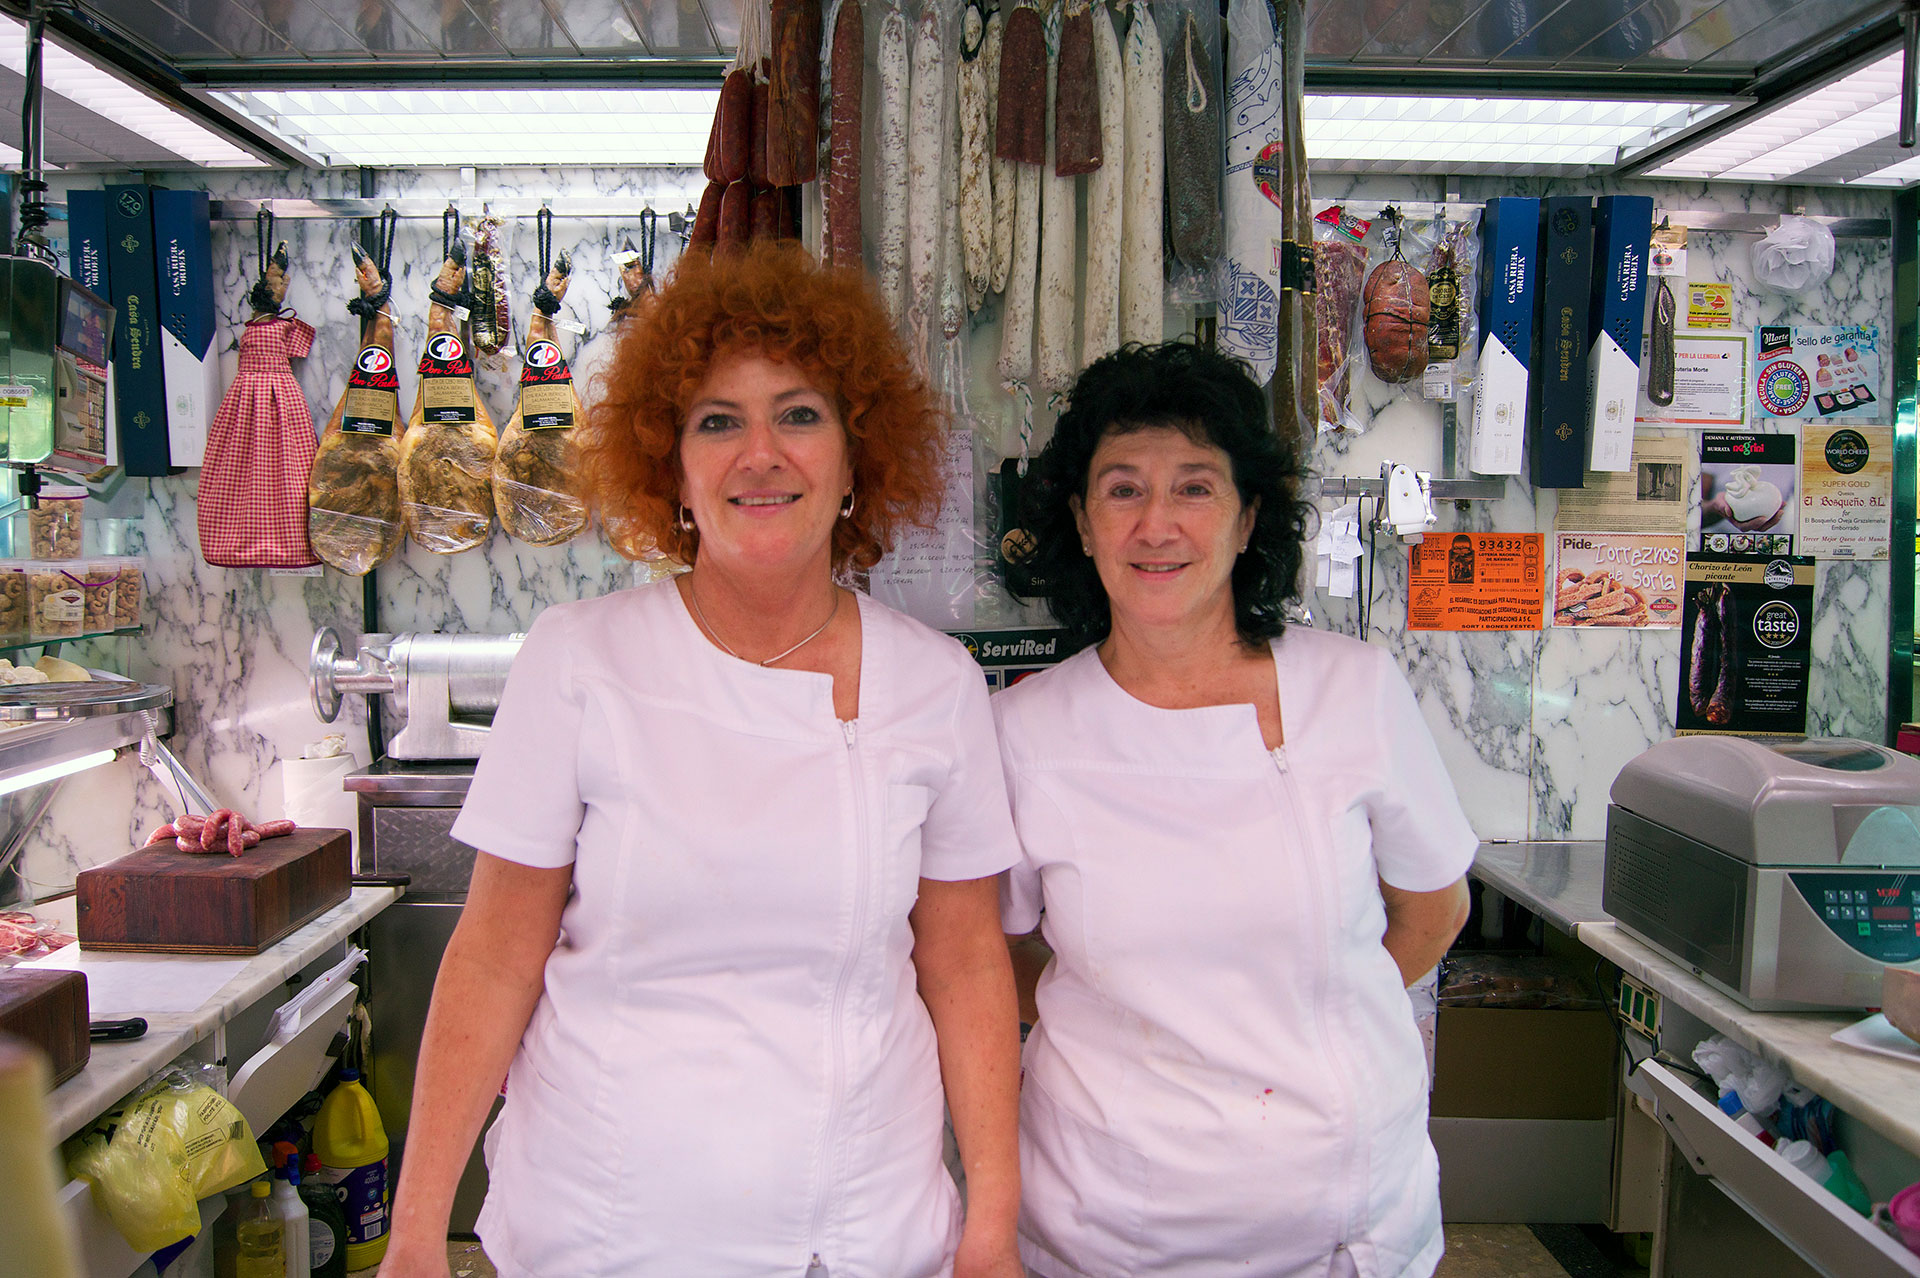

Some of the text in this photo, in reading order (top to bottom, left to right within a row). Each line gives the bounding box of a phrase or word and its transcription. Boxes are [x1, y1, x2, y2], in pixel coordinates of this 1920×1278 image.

[82, 238, 91, 270] RIERA
[170, 238, 179, 270] RIERA
[90, 249, 99, 286] ORDEIX
[178, 249, 187, 286] ORDEIX
[1507, 245, 1519, 304] CASA RIERA
[1516, 255, 1526, 294] ORDEIX
[1620, 243, 1633, 302] CASA RIERA
[1629, 254, 1640, 292] ORDEIX
[171, 271, 181, 296] CASA
[1763, 333, 1789, 345] Morte
[1797, 337, 1818, 346] sello
[1820, 335, 1832, 344] de
[417, 358, 443, 374] Don
[1766, 362, 1803, 376] SIN GLUTEN
[349, 369, 367, 385] Don
[521, 367, 540, 381] Don
[1772, 371, 1797, 380] GLUTEN
[1767, 380, 1780, 404] STARCH
[1783, 381, 1801, 406] LACTOSE
[1783, 379, 1809, 414] SIN LACTOSA
[1767, 403, 1778, 413] SIN
[1733, 441, 1765, 456] negrini
[1822, 480, 1846, 488] SUPER
[1803, 496, 1813, 506] El
[1811, 517, 1836, 525] Bosqueño
[1838, 517, 1853, 525] Oveja
[1842, 509, 1850, 518] for
[1479, 540, 1521, 550] 93432
[1562, 538, 1593, 550] Pide
[1821, 535, 1837, 543] Mejor
[1592, 542, 1681, 567] Torreznos
[1688, 562, 1753, 573] Chorizo de León
[1031, 577, 1046, 586] Sin
[1608, 565, 1677, 592] de Soria
[1704, 572, 1736, 582] picante
[1447, 606, 1465, 614] ENTITATS
[1467, 607, 1492, 615] ASSOCIACIONS
[1498, 606, 1520, 614] CERDANYOLA
[1765, 611, 1787, 621] great
[1757, 618, 1796, 633] taste
[982, 638, 1057, 658] ServiRed
